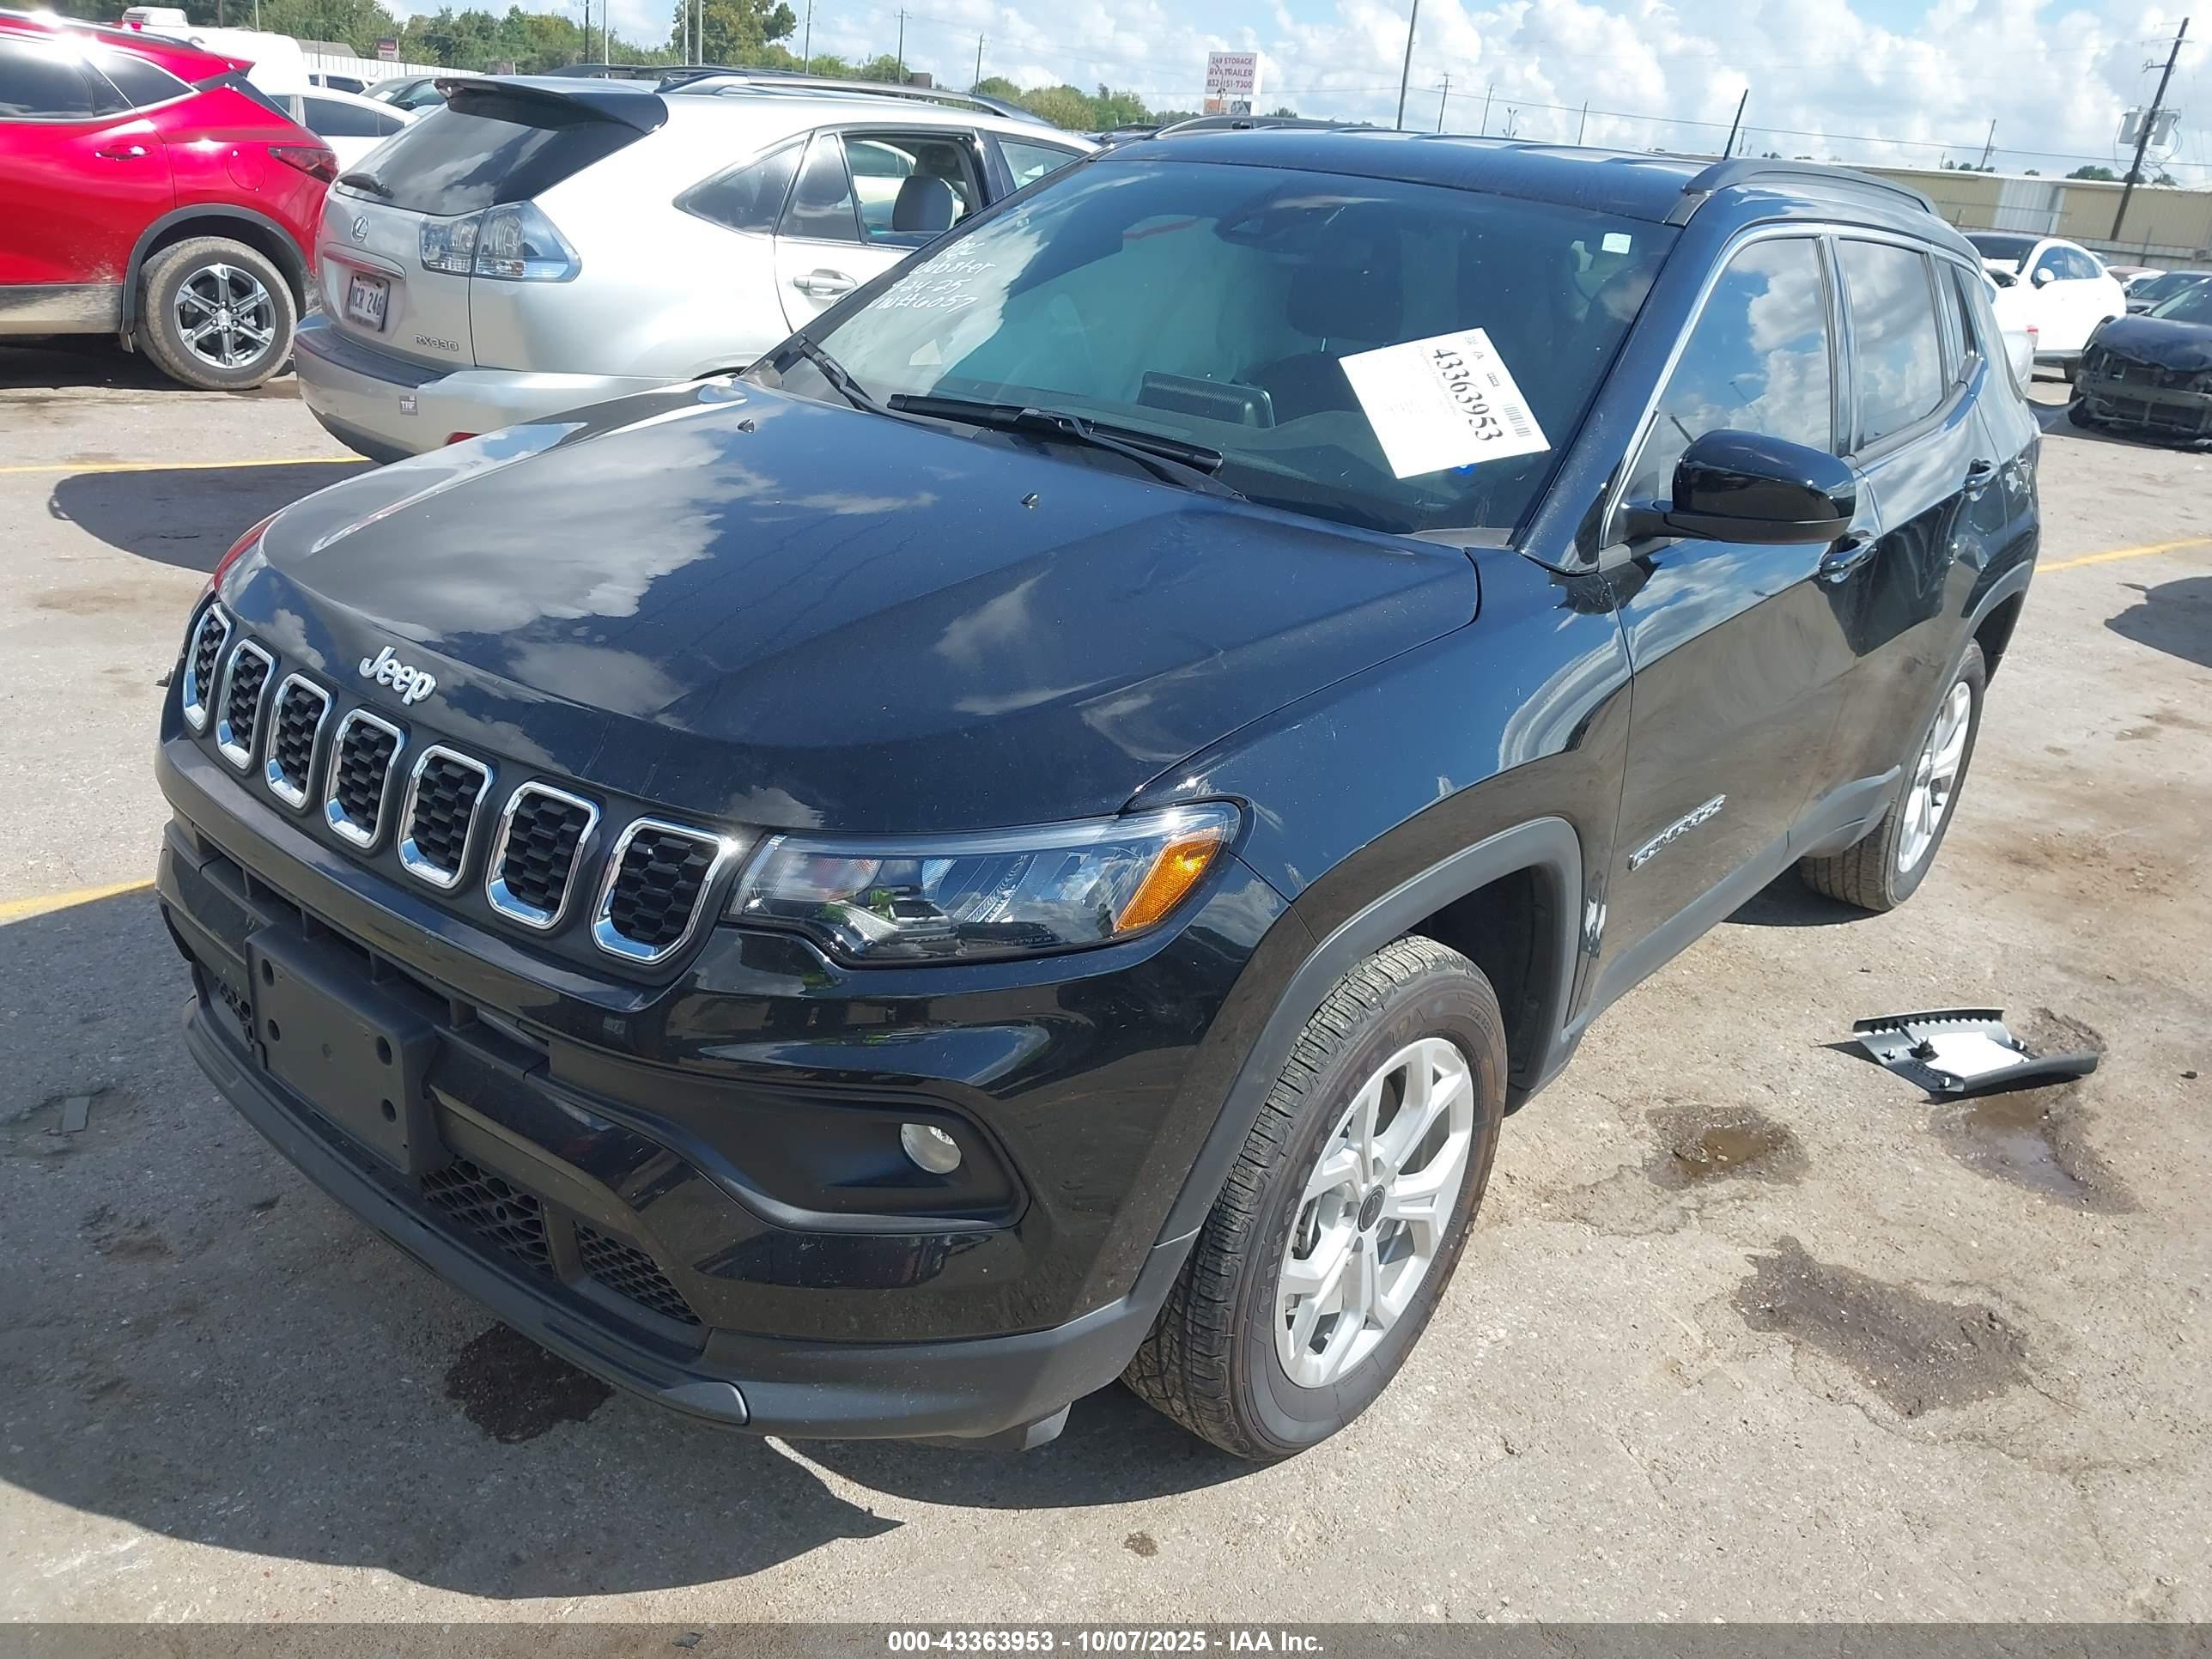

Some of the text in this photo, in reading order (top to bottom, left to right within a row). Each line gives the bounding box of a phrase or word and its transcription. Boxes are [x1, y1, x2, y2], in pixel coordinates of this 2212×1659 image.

[1224, 57, 1253, 65] STORAGE
[1224, 68, 1253, 77] TRAILER
[415, 334, 459, 352] RX330
[1432, 349, 1504, 441] 43363953
[359, 645, 437, 706] Jeep
